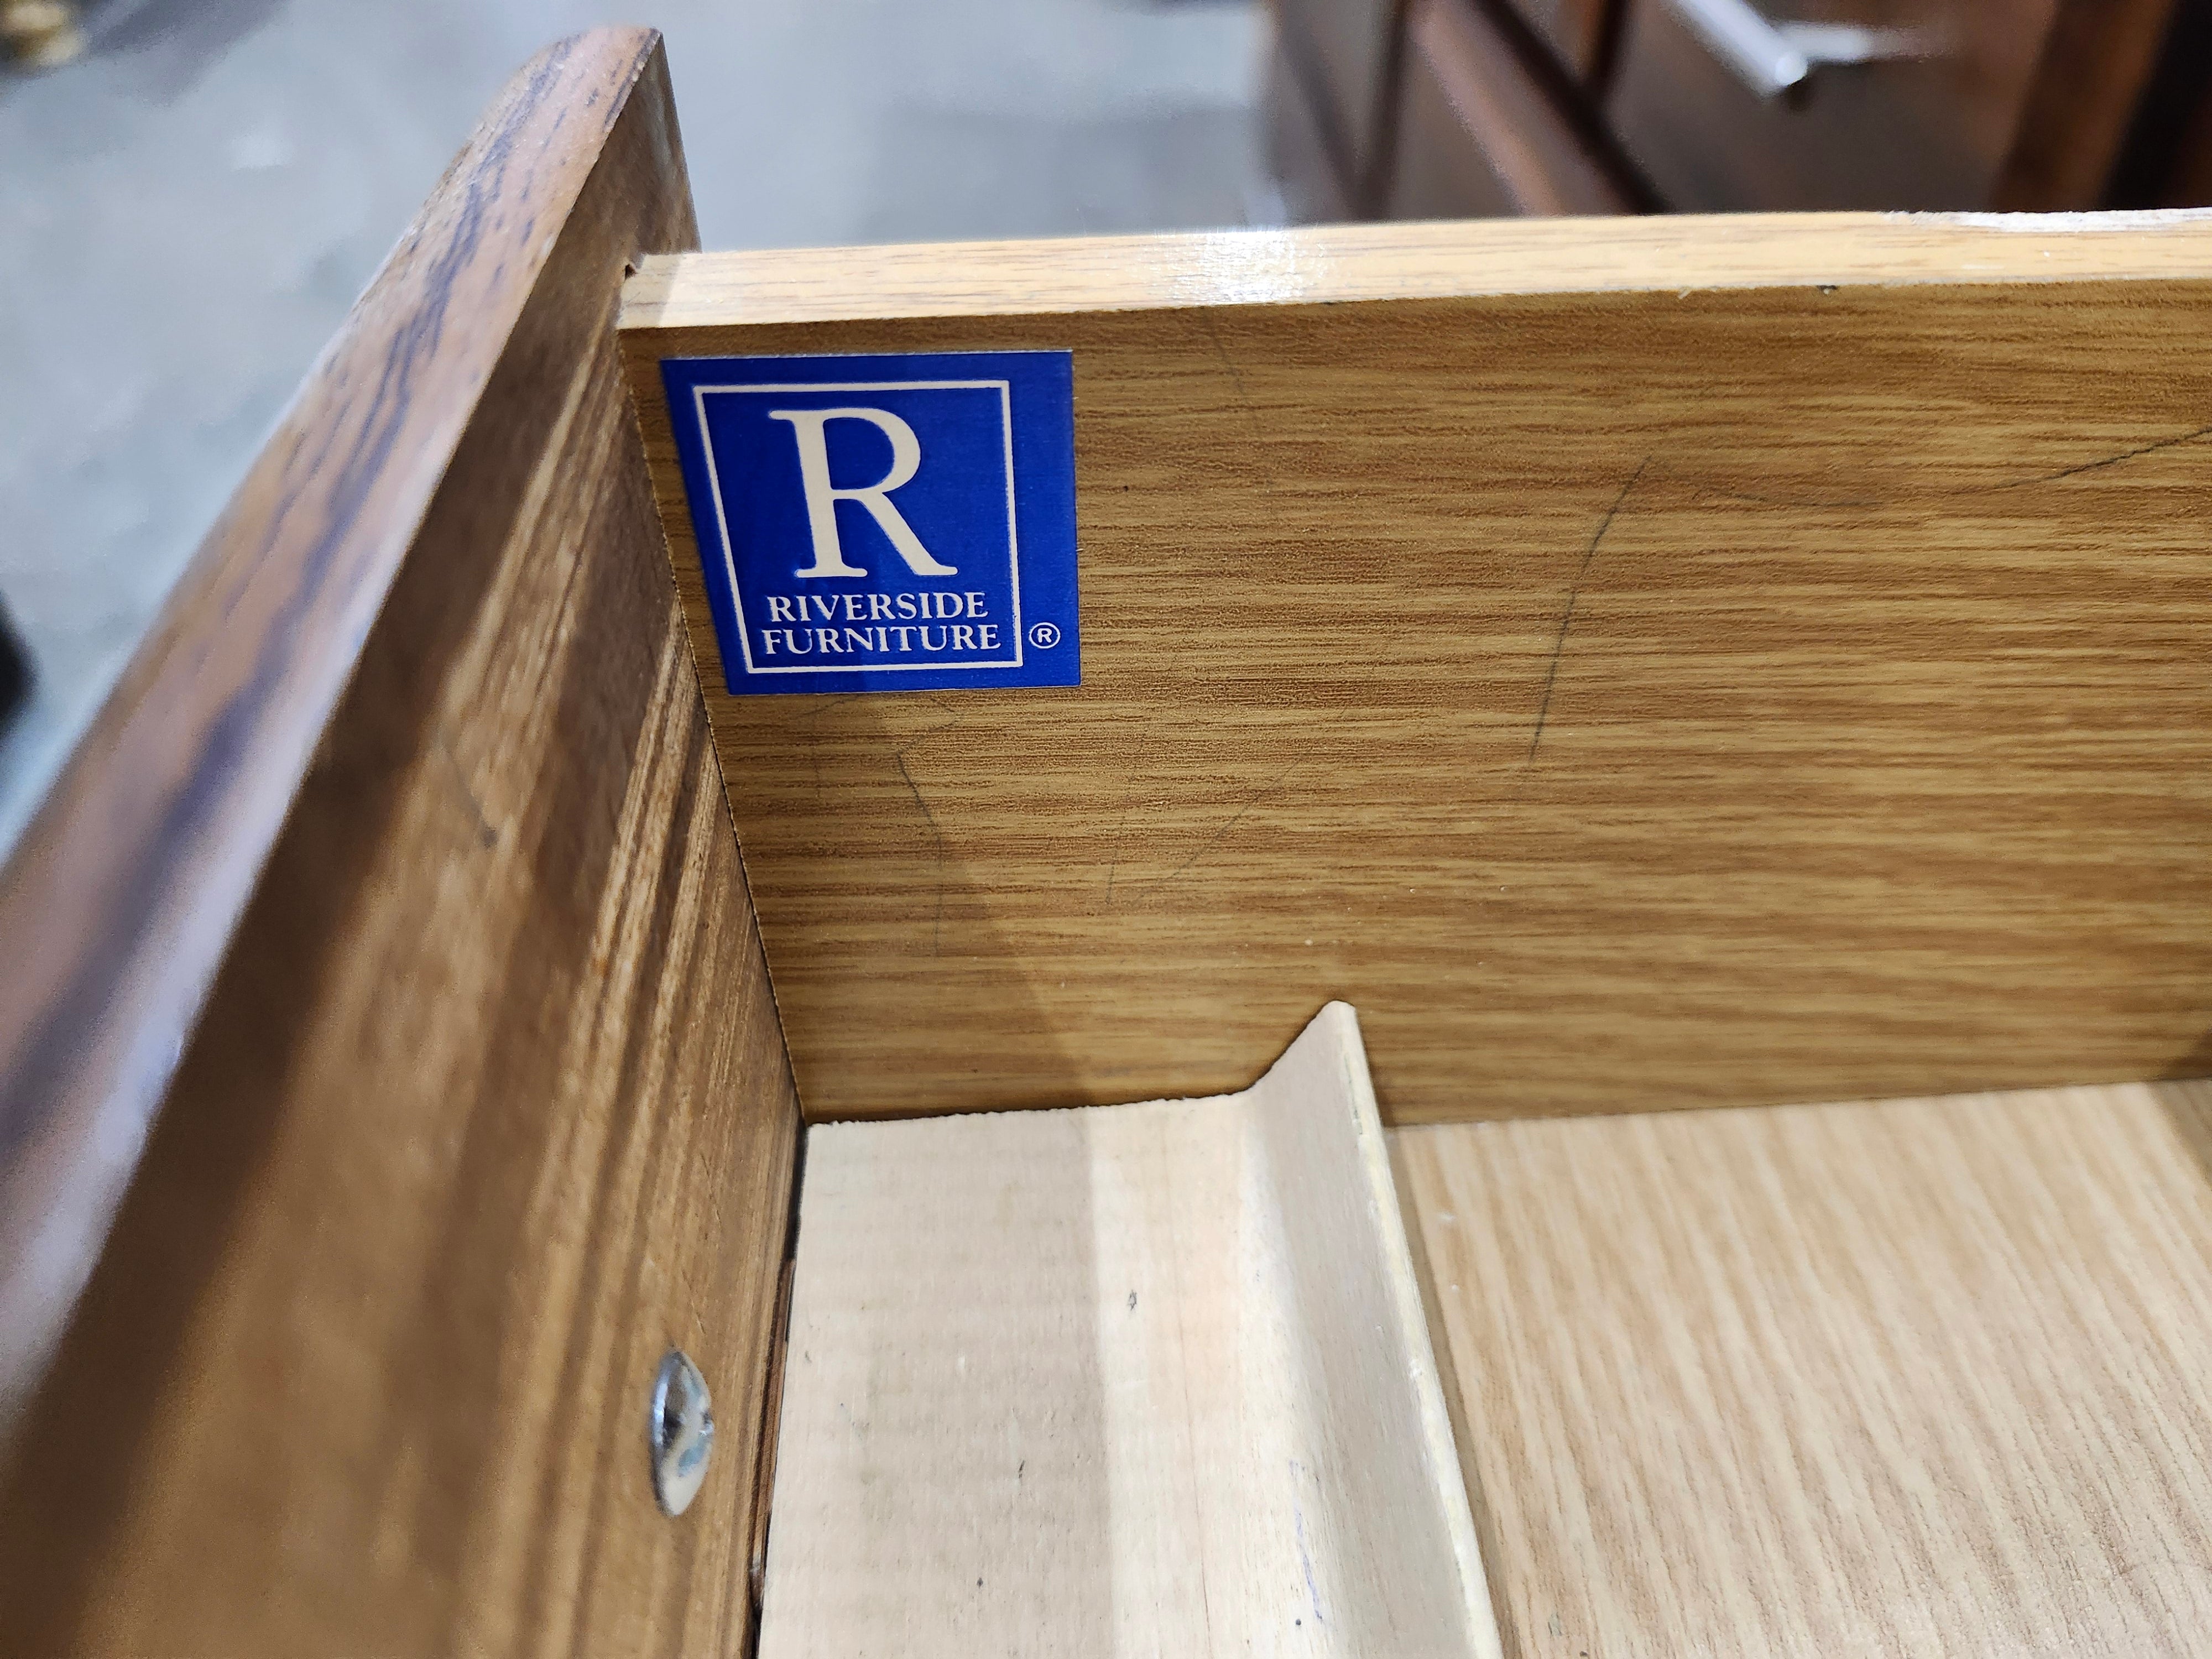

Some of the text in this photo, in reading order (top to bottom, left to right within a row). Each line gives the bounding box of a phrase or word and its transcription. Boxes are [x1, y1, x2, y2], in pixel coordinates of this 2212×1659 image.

[768, 406, 959, 578] R
[766, 591, 989, 623] RIVERSIDE
[760, 623, 1002, 655] FURNITURE
